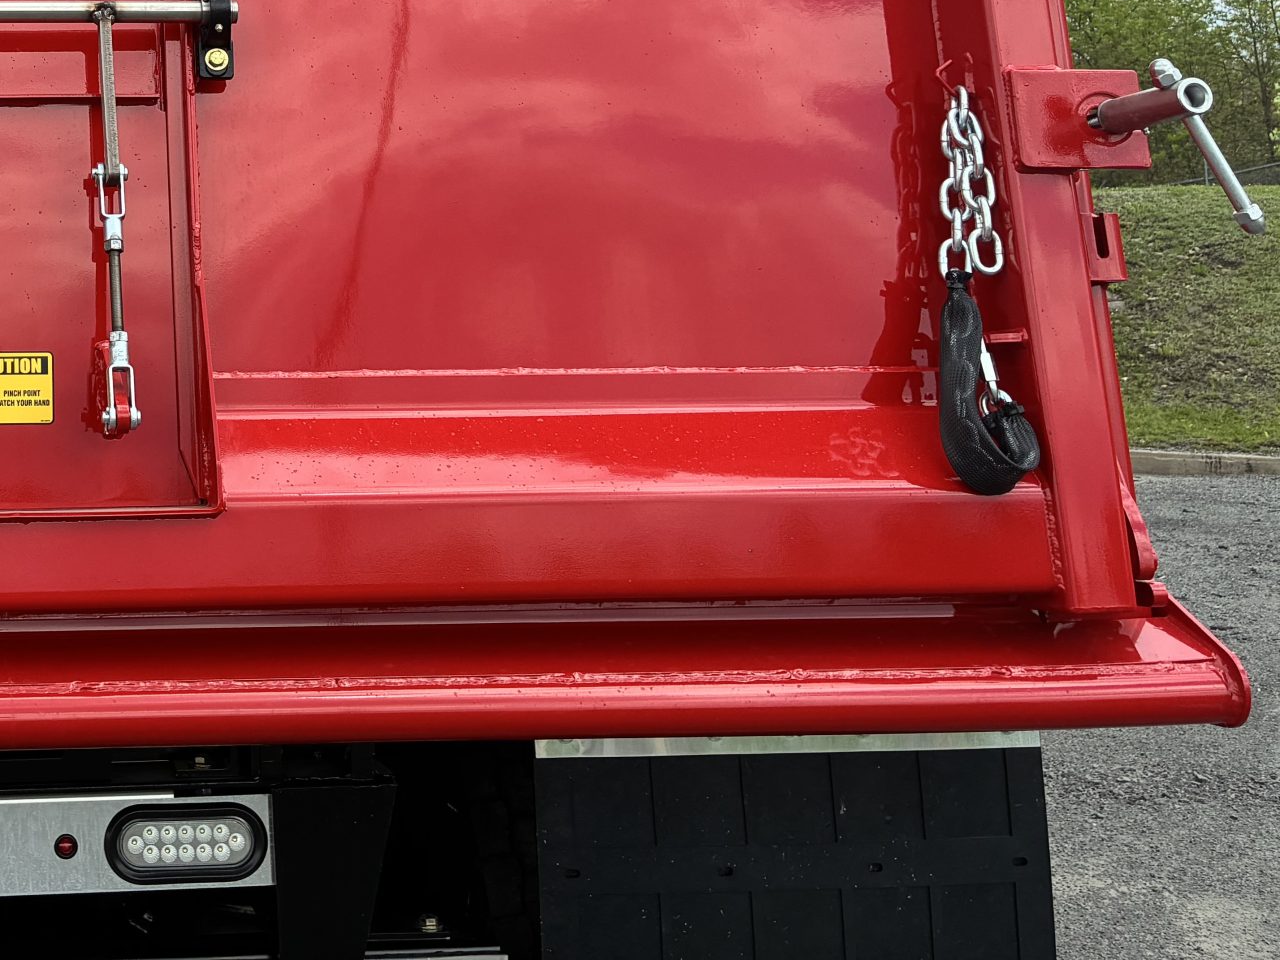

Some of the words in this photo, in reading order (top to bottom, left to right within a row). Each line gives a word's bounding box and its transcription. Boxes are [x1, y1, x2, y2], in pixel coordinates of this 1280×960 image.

[3, 389, 22, 397] PINCH
[23, 389, 41, 397] POINT
[16, 399, 33, 407] YOUR
[33, 399, 50, 407] HAND
